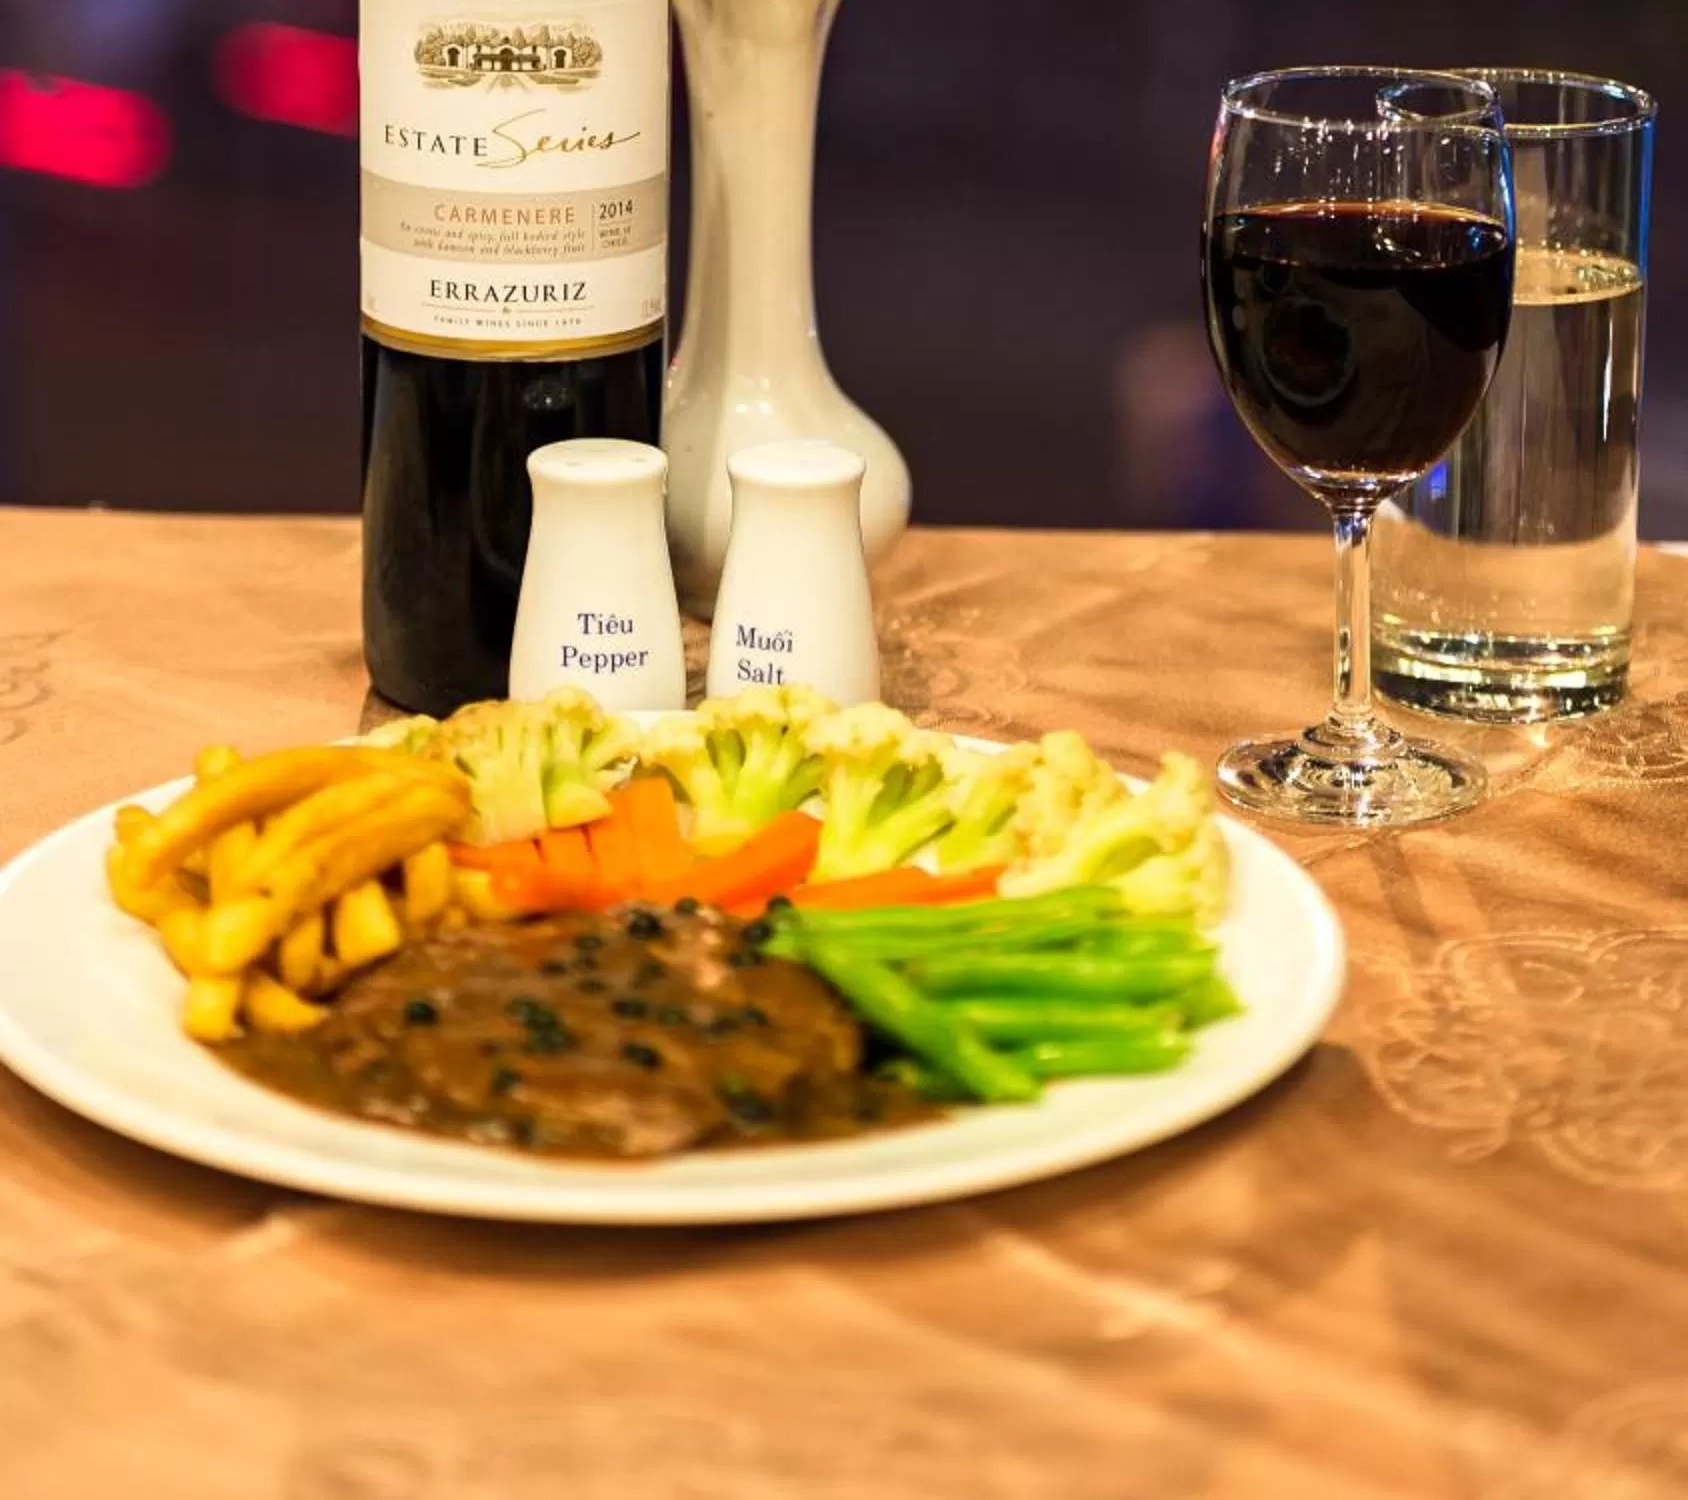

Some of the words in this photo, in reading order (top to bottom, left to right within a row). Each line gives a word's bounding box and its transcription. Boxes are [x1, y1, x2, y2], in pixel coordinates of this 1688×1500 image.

[384, 124, 488, 157] ESTATE
[474, 107, 641, 169] Series
[433, 203, 576, 226] CARMENERE
[599, 199, 633, 220] 2014
[430, 279, 587, 303] ERRAZURIZ
[577, 612, 634, 635] Tiêu
[560, 645, 649, 674] Pepper
[737, 658, 785, 686] Salt
